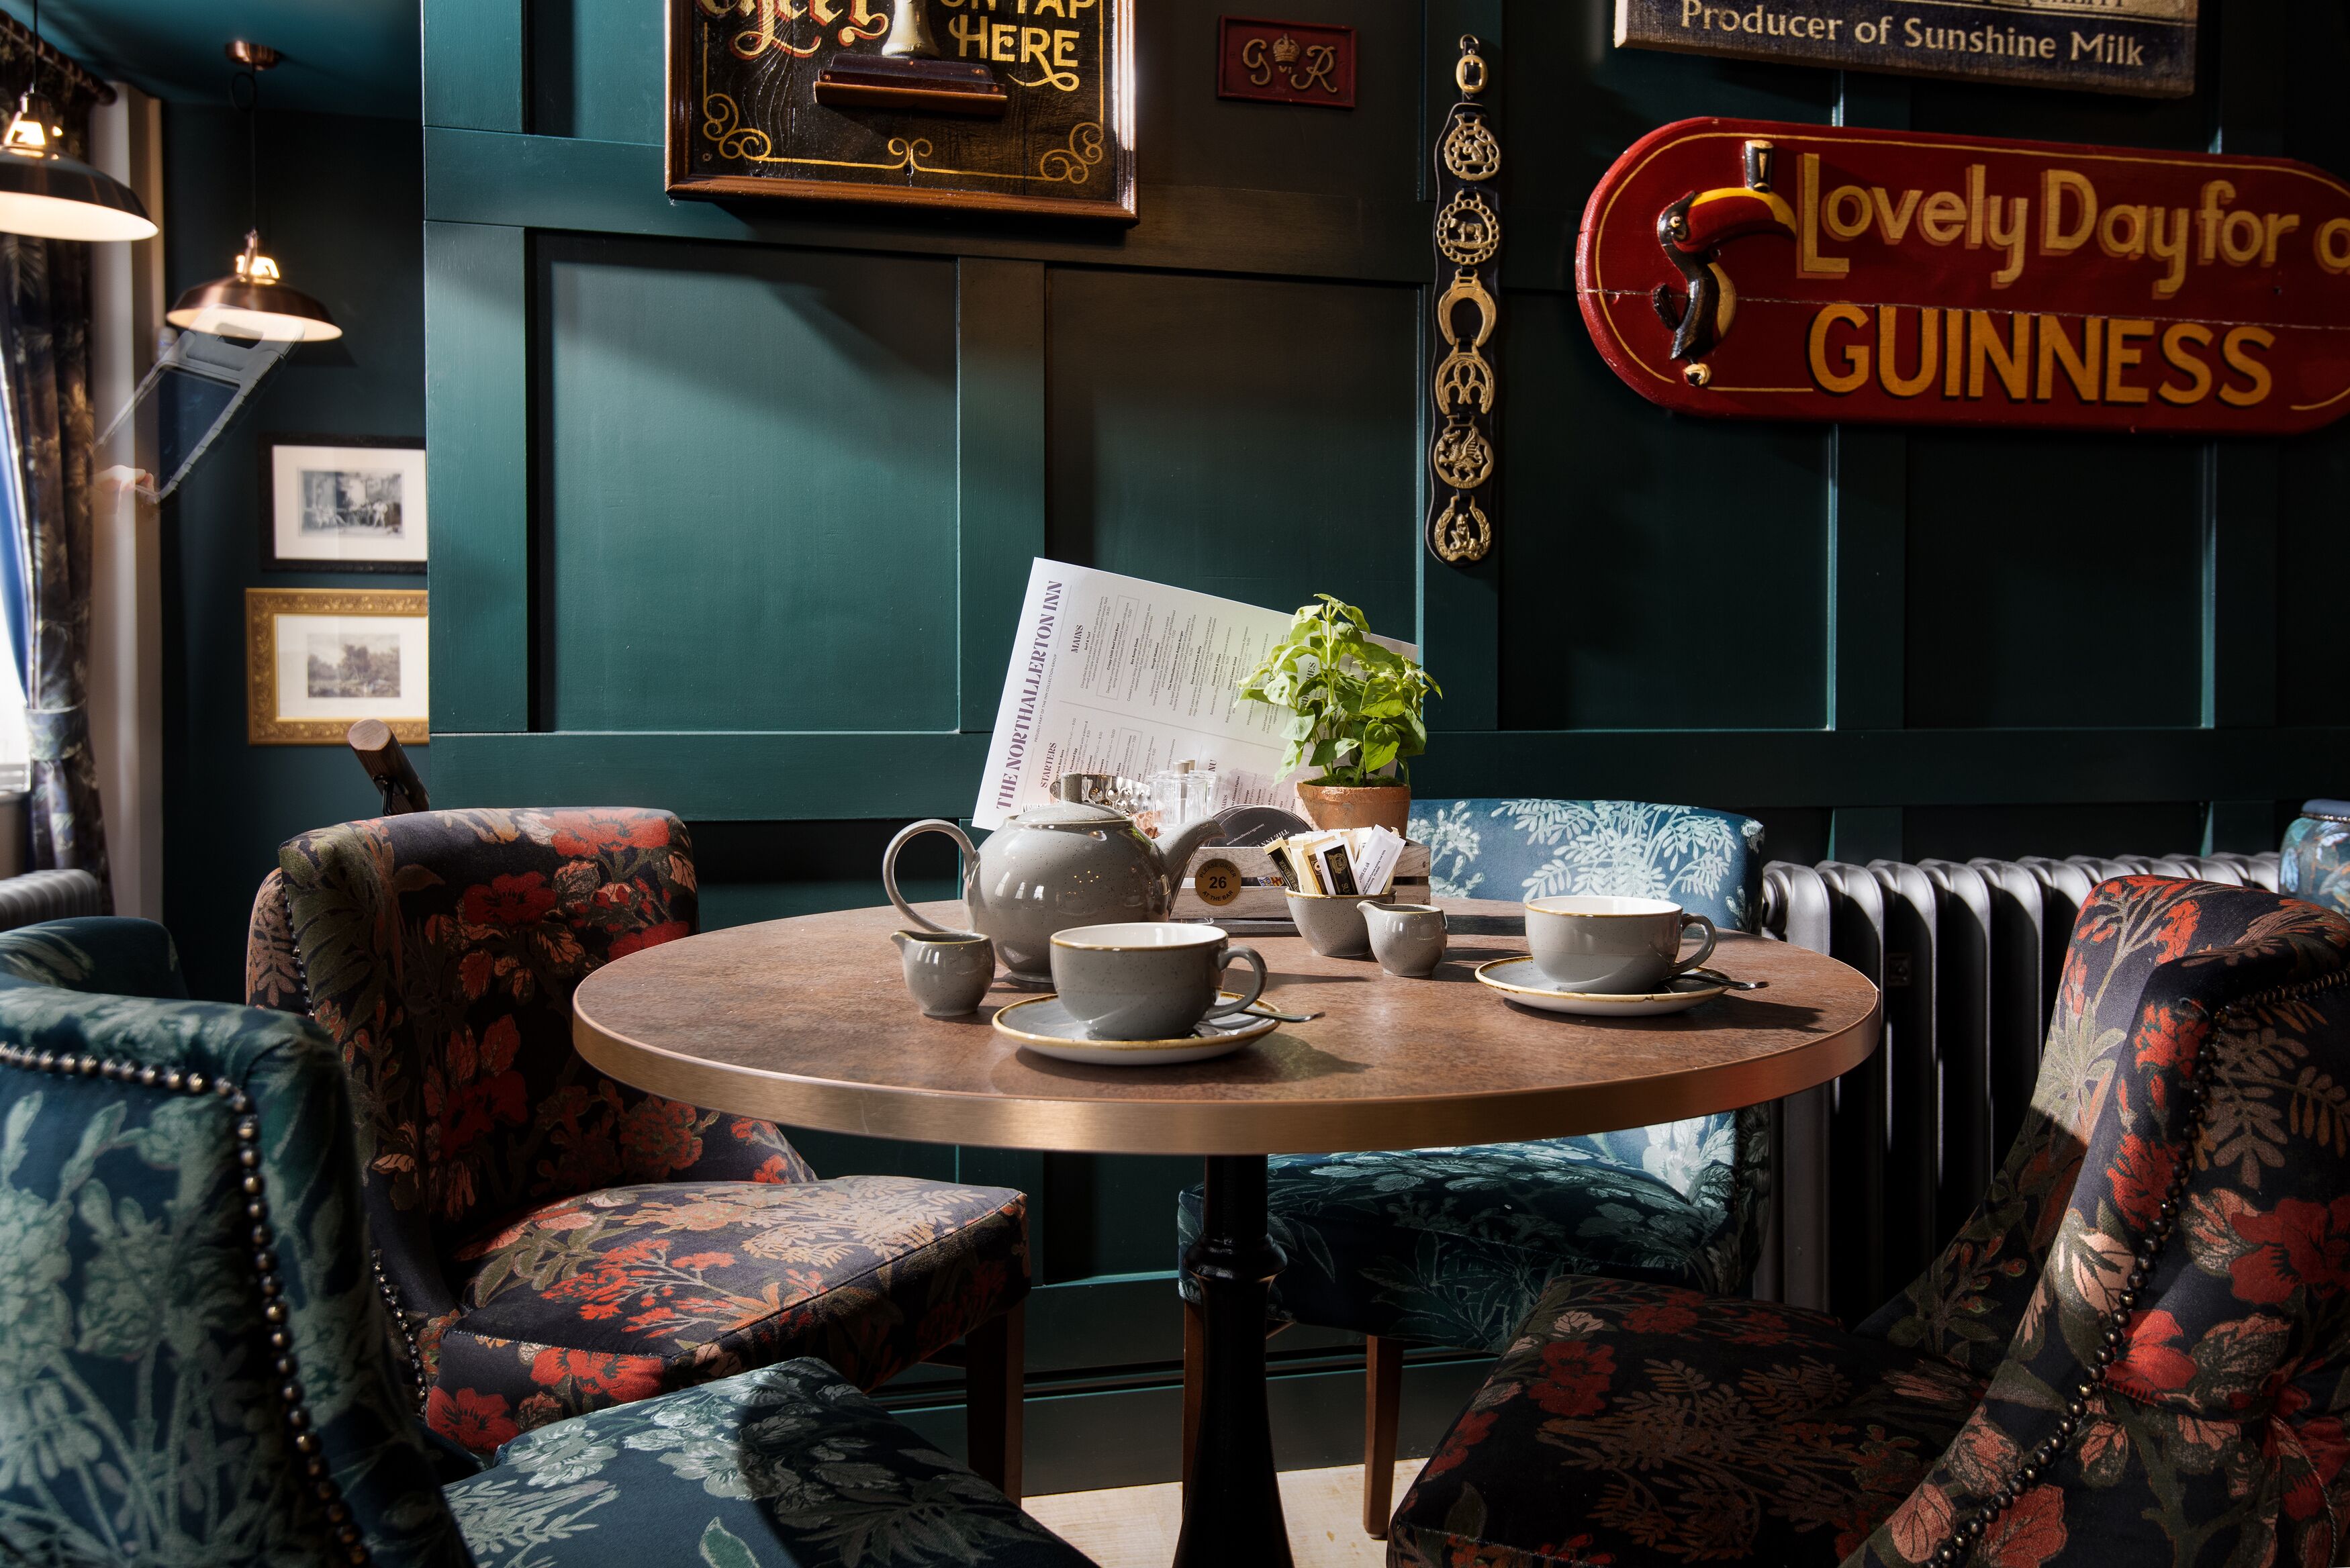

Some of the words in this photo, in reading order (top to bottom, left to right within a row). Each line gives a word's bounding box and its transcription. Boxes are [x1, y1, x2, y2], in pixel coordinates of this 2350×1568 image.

[1681, 0, 1842, 40] Producer
[1854, 15, 1893, 44] of
[1903, 17, 2057, 58] Sunshine
[2070, 32, 2145, 66] Milk
[949, 14, 1080, 91] HERE
[1243, 38, 1272, 85] G
[1290, 45, 1337, 93] R
[1798, 152, 2028, 287] Lovely
[2042, 169, 2189, 297] Day
[2197, 180, 2300, 263] for
[1807, 301, 2276, 406] GUINNESS
[1043, 581, 1062, 610] INN
[1071, 624, 1083, 652] MAINS
[1006, 614, 1053, 769] NORTHALLERTON
[1045, 667, 1053, 691] COLLECTION
[1040, 742, 1056, 787] STARTERS
[996, 773, 1017, 808] THE
[1273, 829, 1289, 840] THE
[1199, 861, 1219, 878] PLEASE
[1220, 863, 1236, 878] ORDER
[1209, 877, 1227, 889] 26
[1222, 890, 1233, 900] BAR
